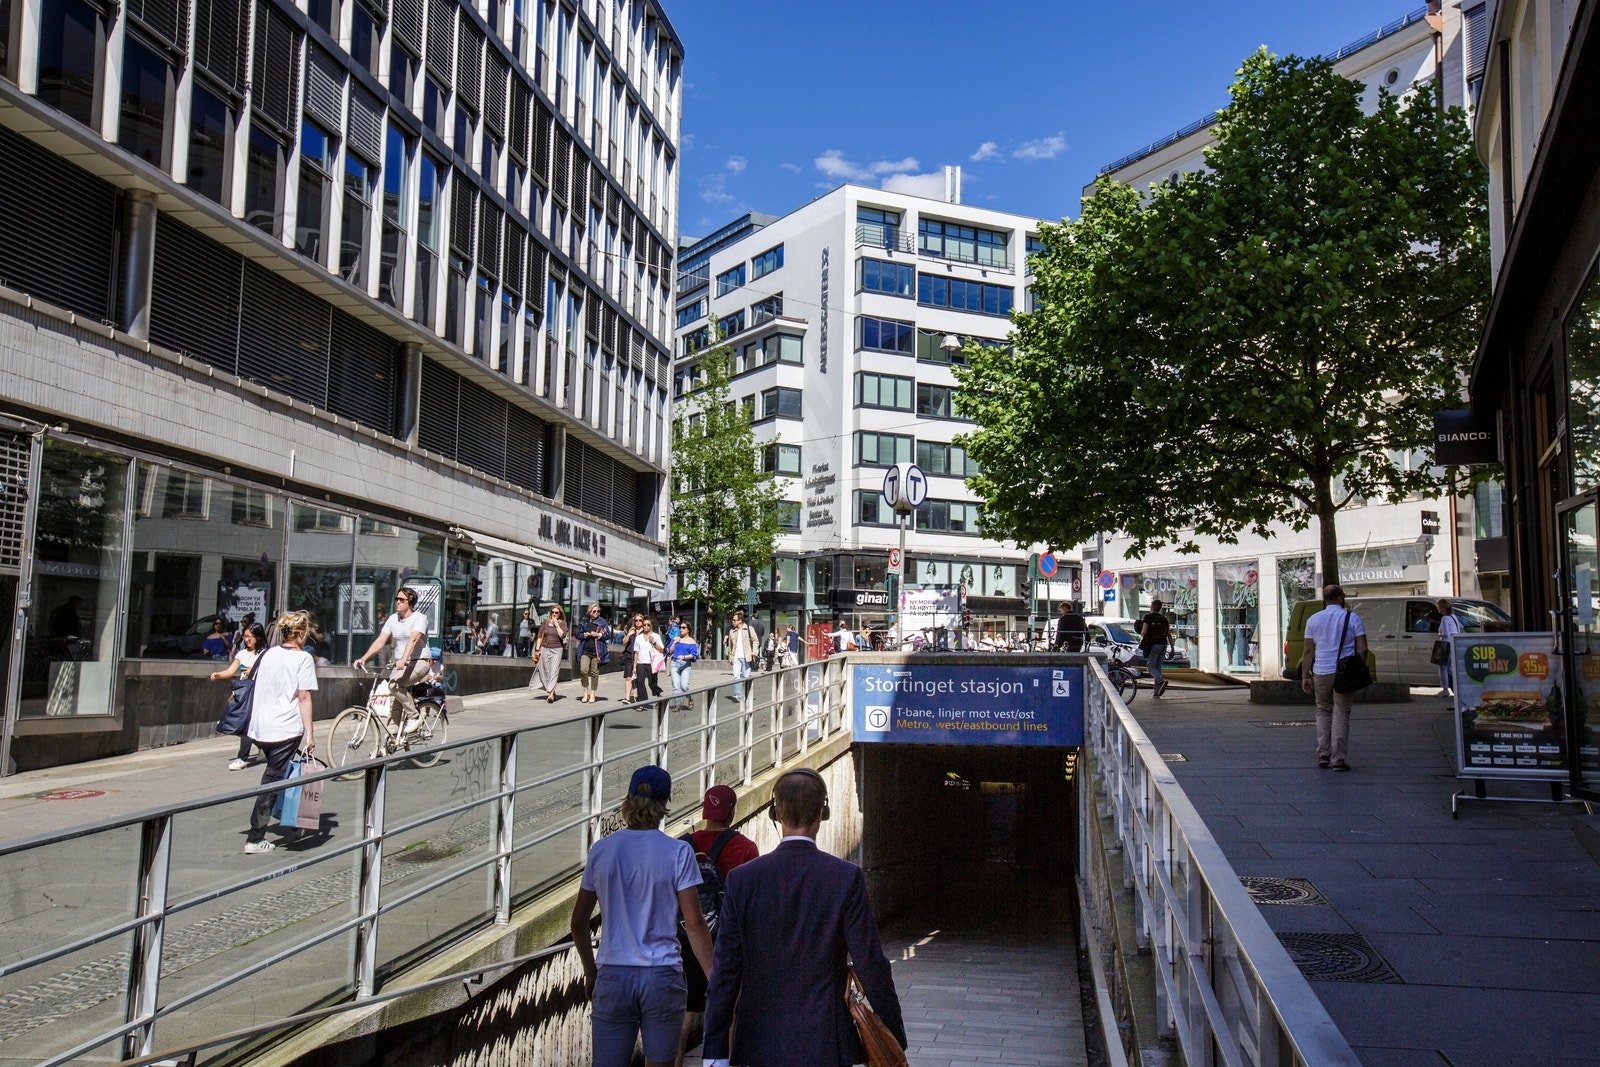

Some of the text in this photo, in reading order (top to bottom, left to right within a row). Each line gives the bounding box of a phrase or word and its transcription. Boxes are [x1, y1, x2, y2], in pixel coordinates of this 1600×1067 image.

[910, 475, 921, 501] T
[1340, 569, 1404, 583] KATFORUM
[1472, 646, 1496, 660] SUB
[1489, 660, 1509, 673] DAY
[865, 676, 1024, 698] Stortinget stasjon
[896, 707, 1035, 720] T-bane, linjer mot vest/øst
[896, 719, 1049, 732] Metro, west/eastbound lines
[303, 790, 320, 802] YME
